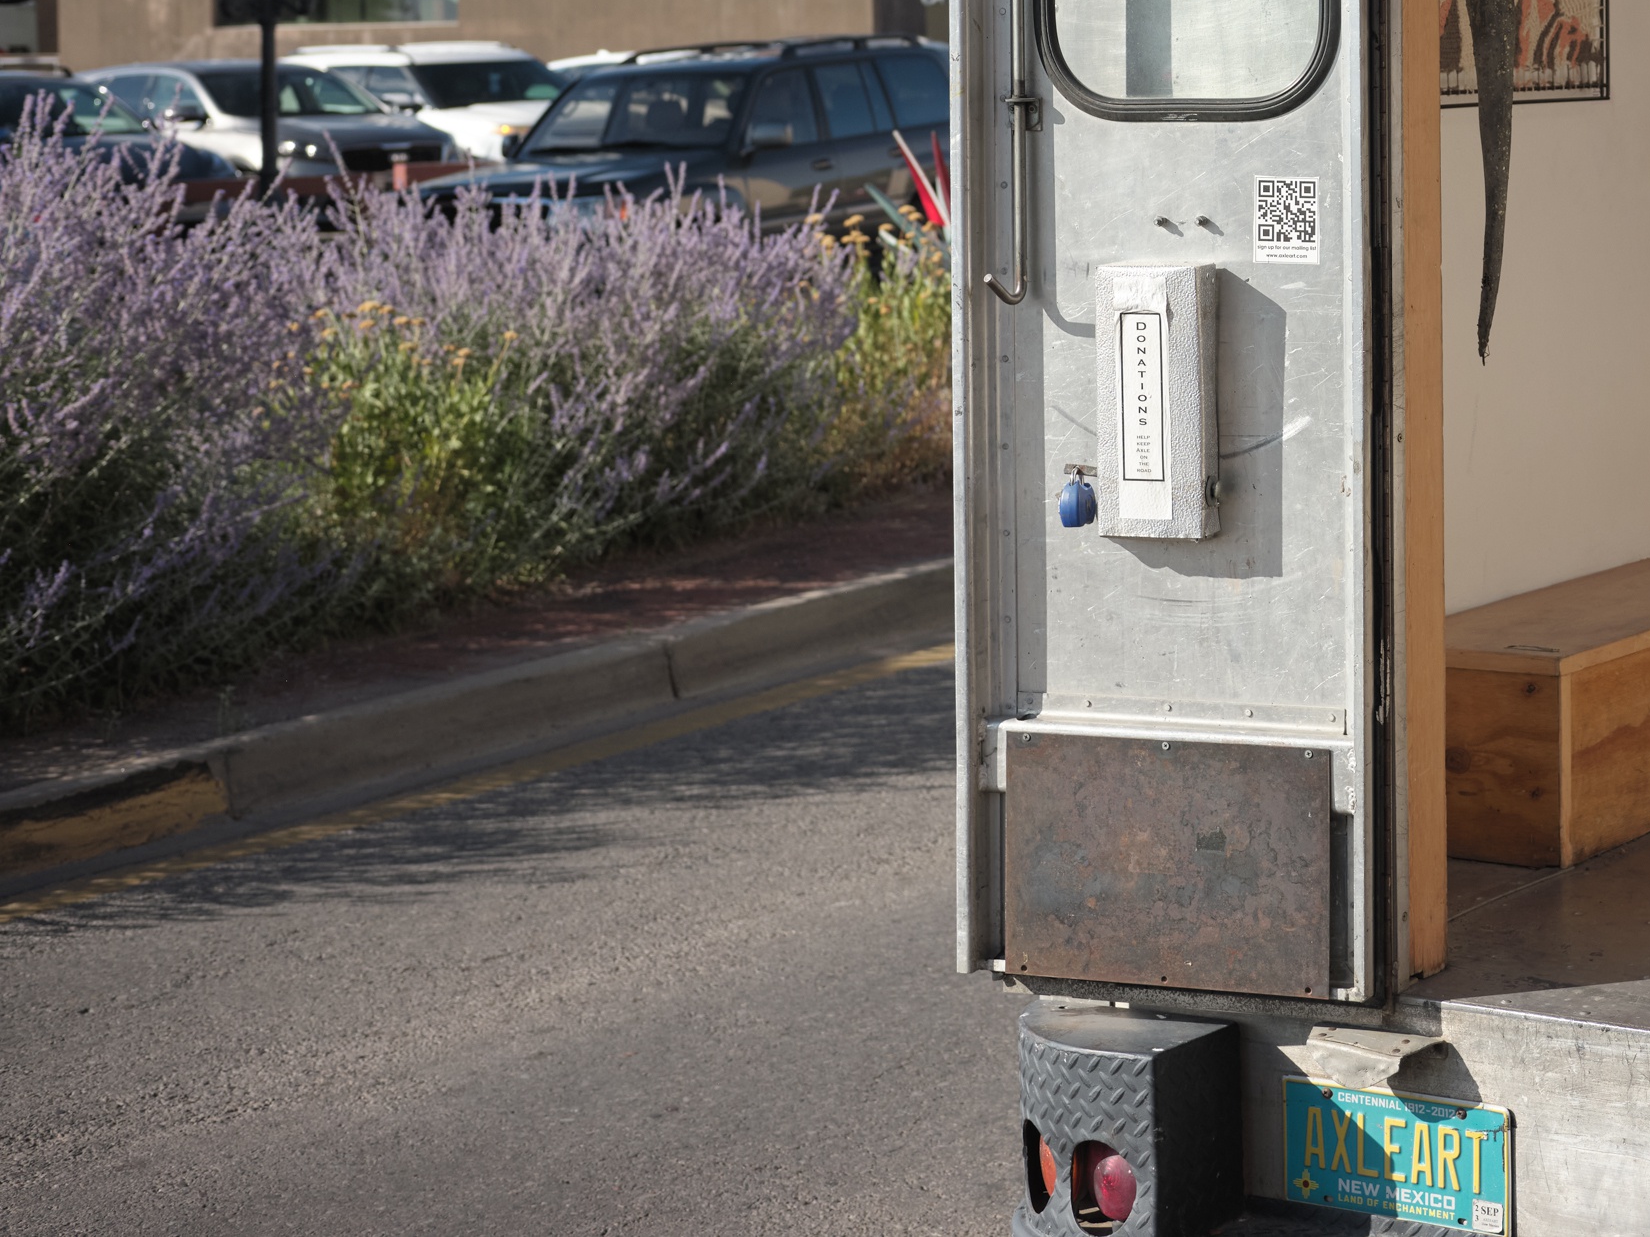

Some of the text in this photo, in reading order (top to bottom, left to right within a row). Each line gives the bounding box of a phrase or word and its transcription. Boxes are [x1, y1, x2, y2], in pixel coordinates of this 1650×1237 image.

[1136, 322, 1147, 426] DONATIONS
[1337, 1091, 1456, 1119] CENTENNIAL 1912-2012
[1304, 1106, 1488, 1195] AXLEART
[1337, 1193, 1456, 1221] LAND OF ENCHANTMENT
[1338, 1178, 1456, 1211] NEW MEXICO
[1480, 1205, 1499, 1217] SEP
